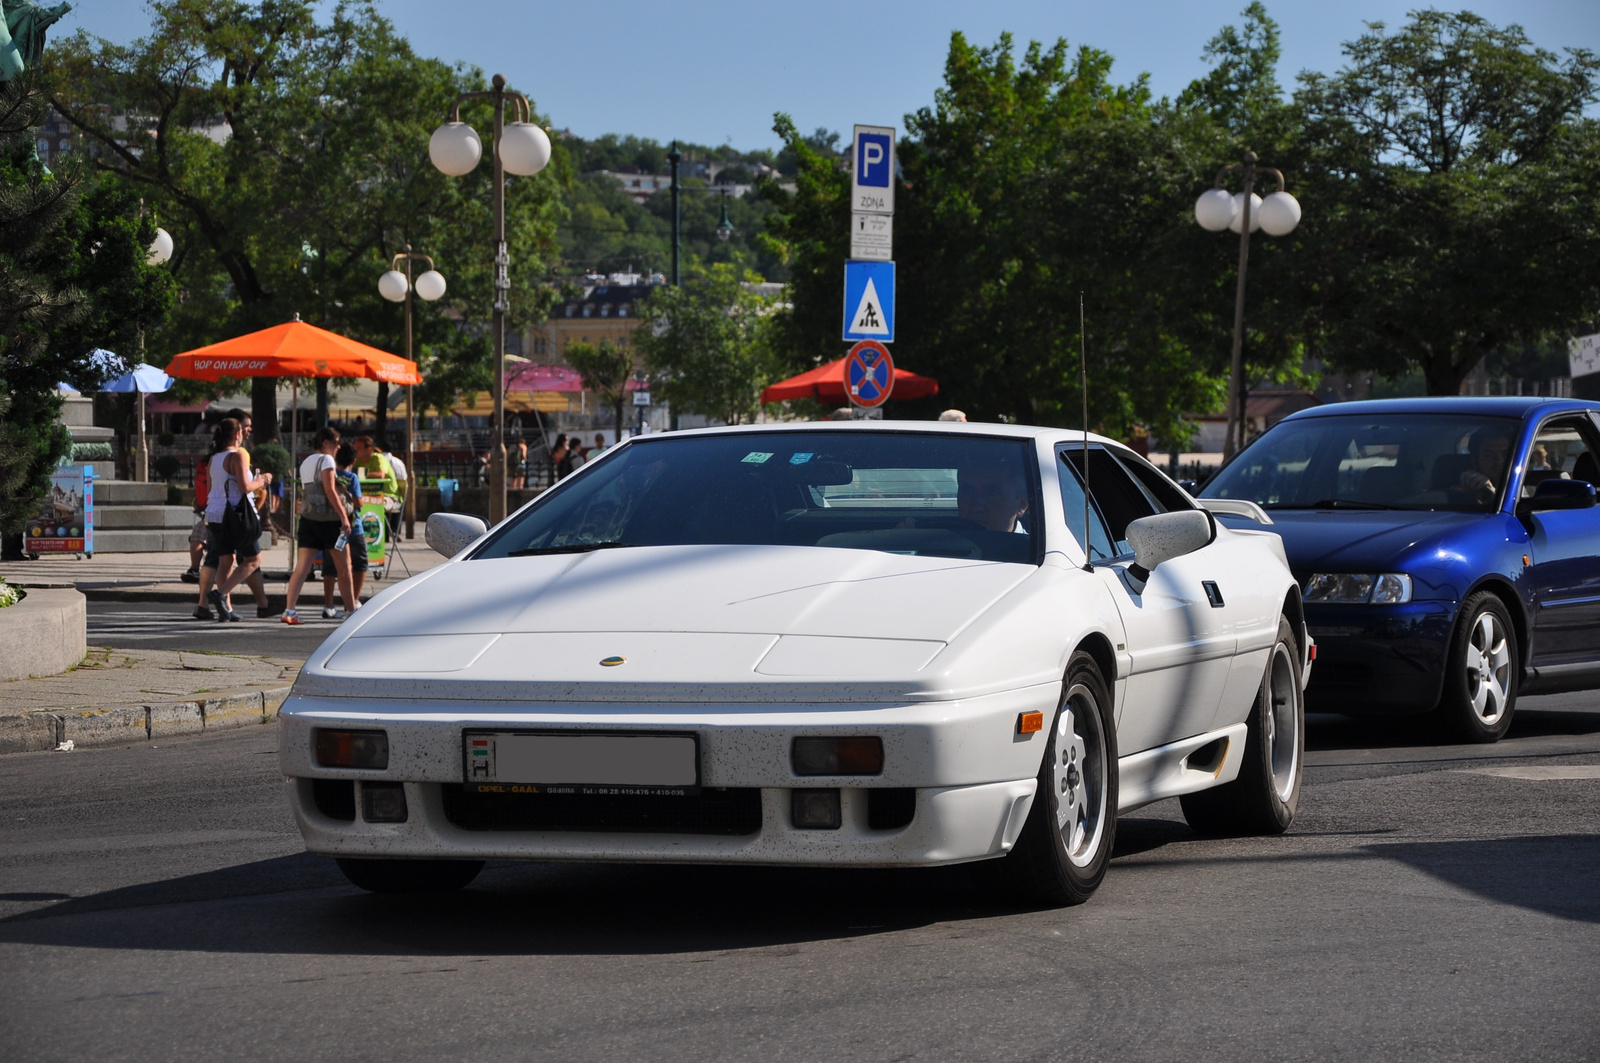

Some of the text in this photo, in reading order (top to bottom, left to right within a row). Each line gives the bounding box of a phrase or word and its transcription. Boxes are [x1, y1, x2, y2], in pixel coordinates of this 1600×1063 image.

[863, 142, 883, 178] P
[194, 360, 212, 370] HOP
[213, 360, 228, 370] ON
[228, 360, 248, 370] HOP
[248, 360, 268, 370] OFF
[473, 760, 488, 777] H
[478, 785, 505, 793] OPEL
